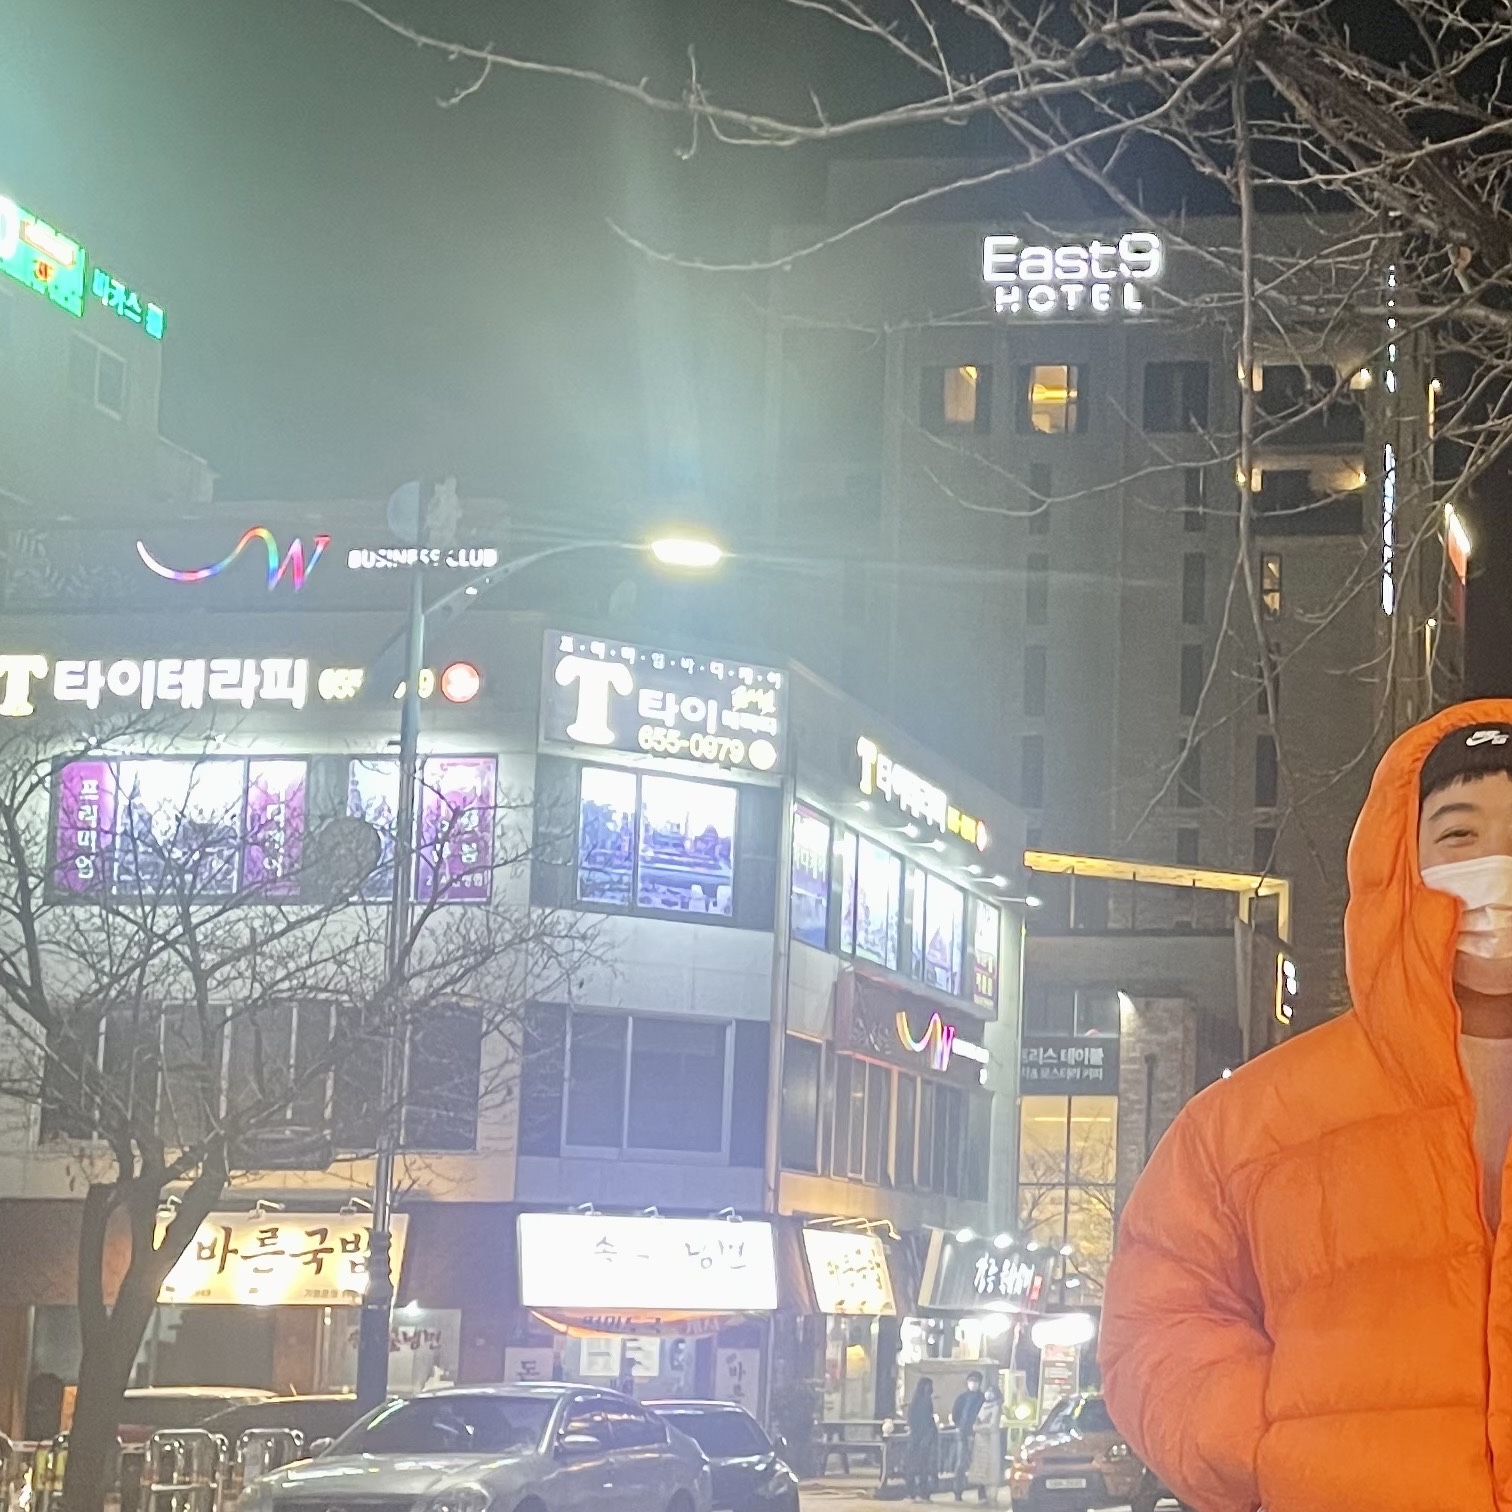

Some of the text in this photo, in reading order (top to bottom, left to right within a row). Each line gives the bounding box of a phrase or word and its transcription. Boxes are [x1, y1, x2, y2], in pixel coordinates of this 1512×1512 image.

[984, 232, 1161, 282] East9
[995, 282, 1144, 313] HOTEL
[446, 548, 497, 568] CLUB
[54, 659, 307, 710] 타이테라피
[638, 688, 718, 735] 타이
[638, 724, 744, 765] 655-0979
